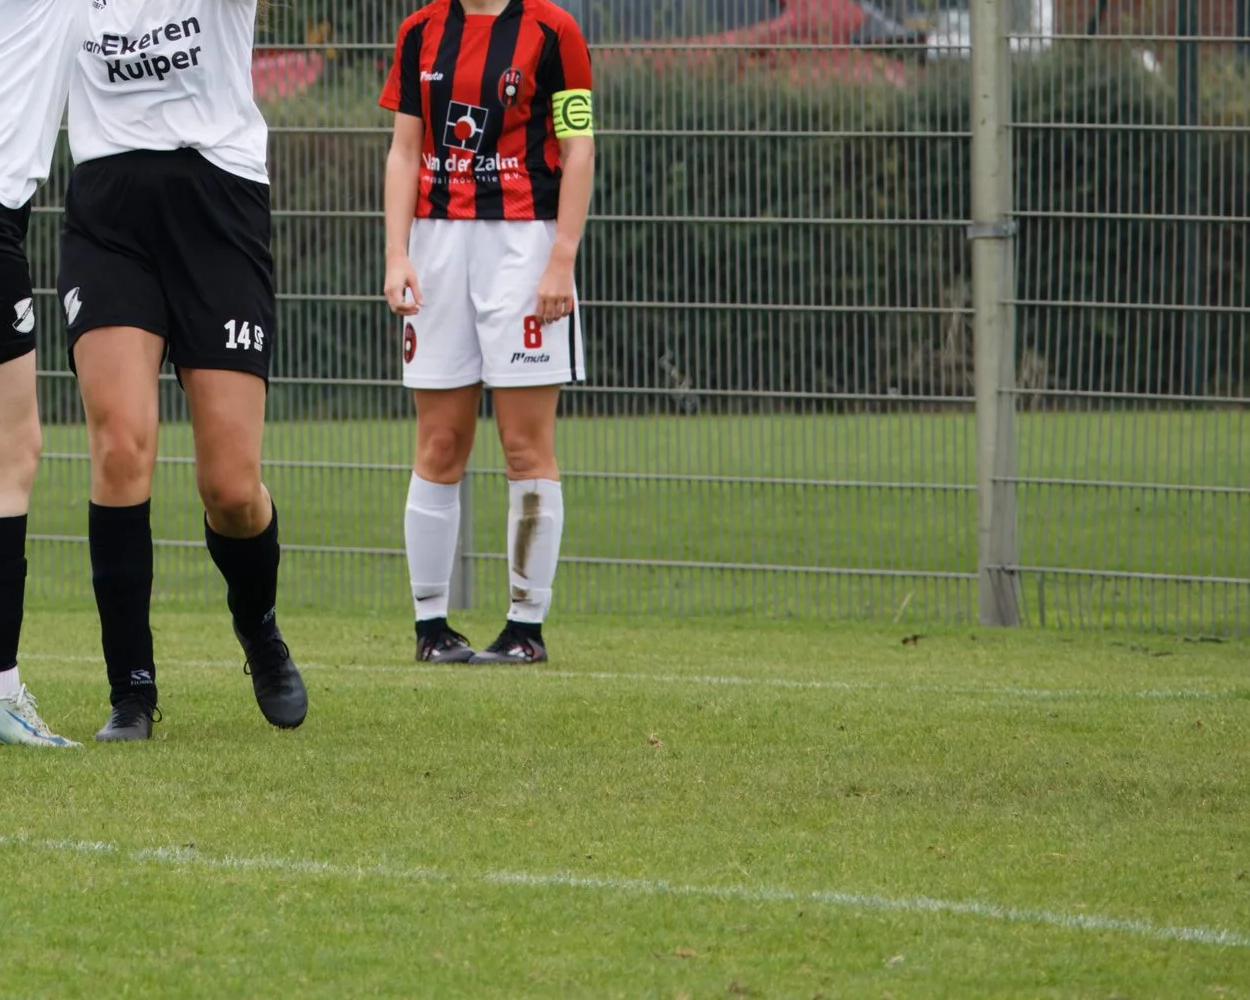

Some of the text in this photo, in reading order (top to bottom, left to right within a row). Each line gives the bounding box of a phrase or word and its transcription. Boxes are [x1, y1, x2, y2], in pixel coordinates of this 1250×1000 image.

[101, 17, 201, 56] Ekeren
[105, 46, 201, 83] Kuiper
[562, 95, 590, 131] C
[444, 153, 472, 172] der
[475, 152, 519, 172] Zalm
[223, 319, 251, 350] 14
[524, 315, 542, 349] 8
